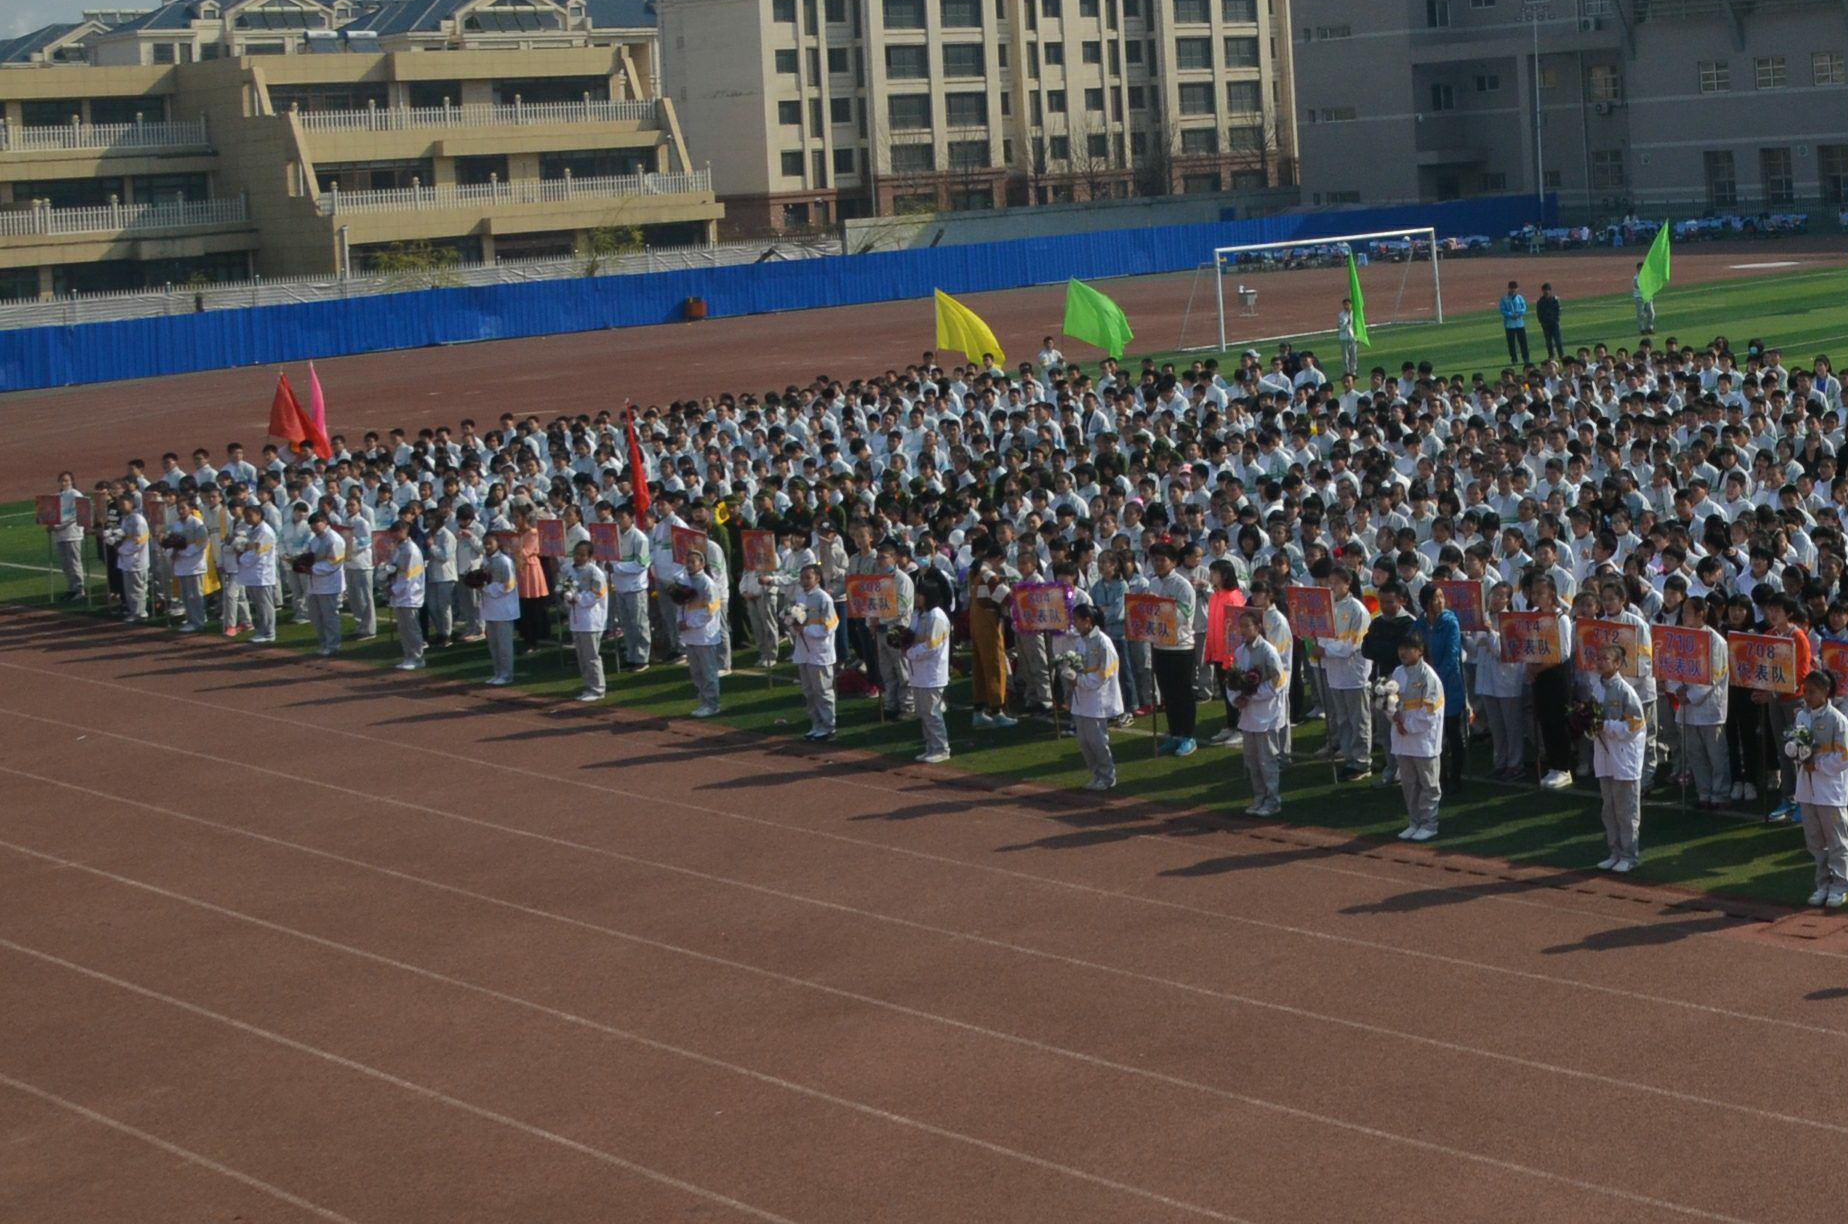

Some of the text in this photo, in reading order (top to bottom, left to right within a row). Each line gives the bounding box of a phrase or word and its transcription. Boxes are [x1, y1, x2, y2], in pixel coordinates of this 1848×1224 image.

[1514, 619, 1540, 633] 714
[1593, 627, 1620, 644] 712
[1665, 631, 1697, 654] 710
[1746, 642, 1776, 660] 708
[1659, 654, 1702, 677] 代表队
[1737, 660, 1786, 684] 代表队
